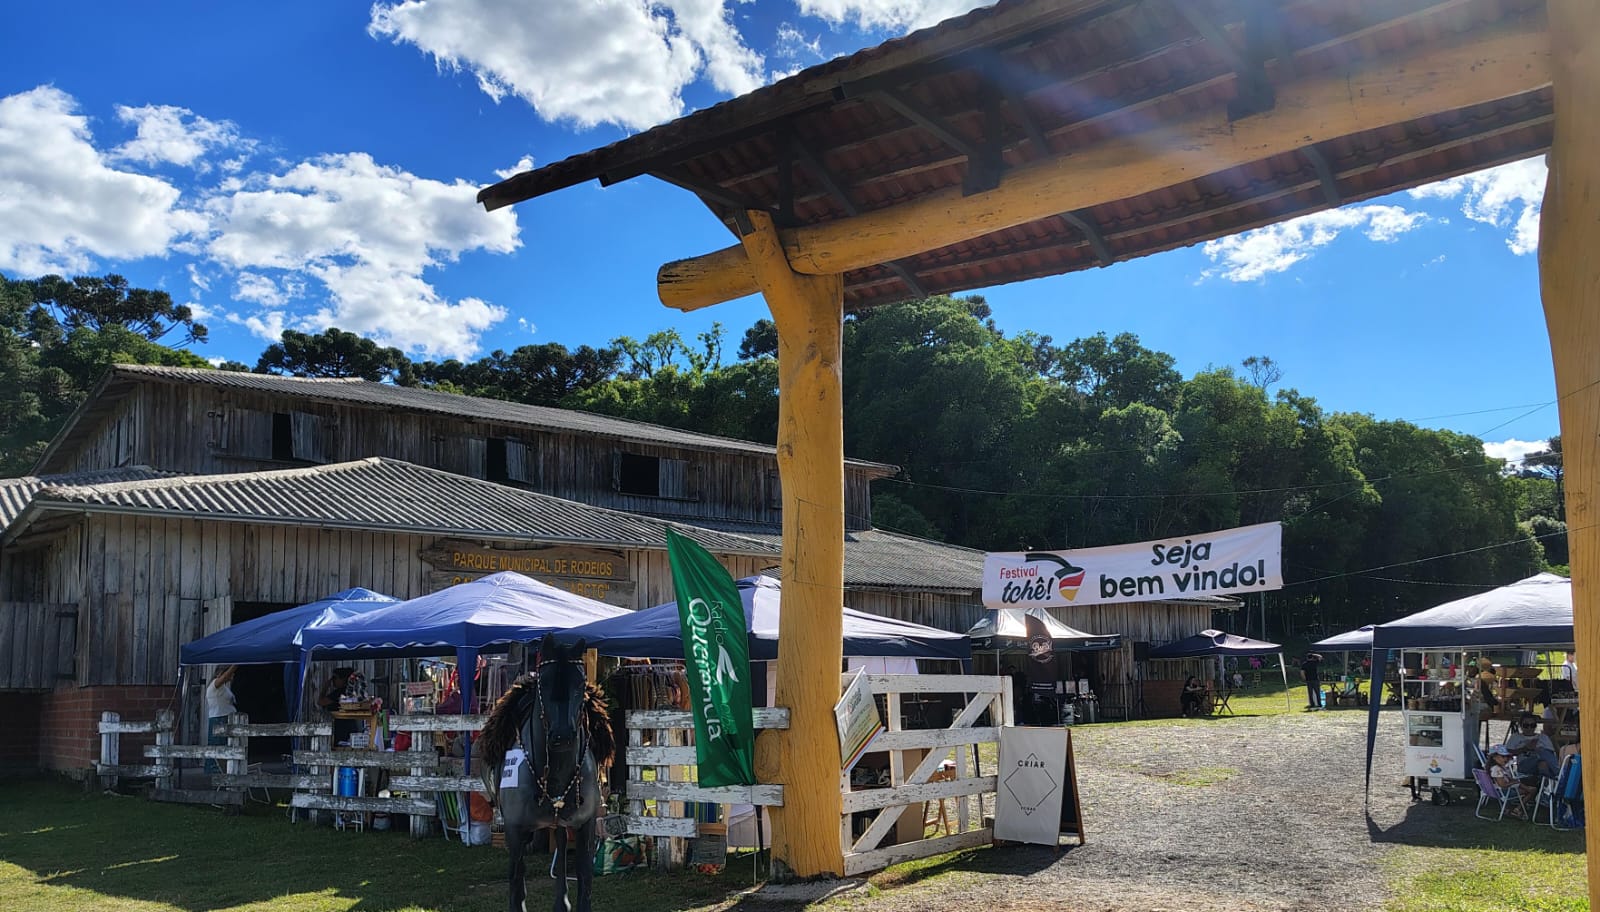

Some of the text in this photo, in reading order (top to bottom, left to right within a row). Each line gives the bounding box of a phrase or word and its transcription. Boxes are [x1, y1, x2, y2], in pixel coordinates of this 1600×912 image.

[453, 552, 613, 576] PARQUE MUNICIPAL DE RODEIOS
[1150, 539, 1212, 569] Seja
[999, 566, 1038, 580] Festival
[1099, 559, 1266, 599] bem vindo!
[1001, 577, 1055, 604] tchê!
[1017, 760, 1046, 769] CRIAR
